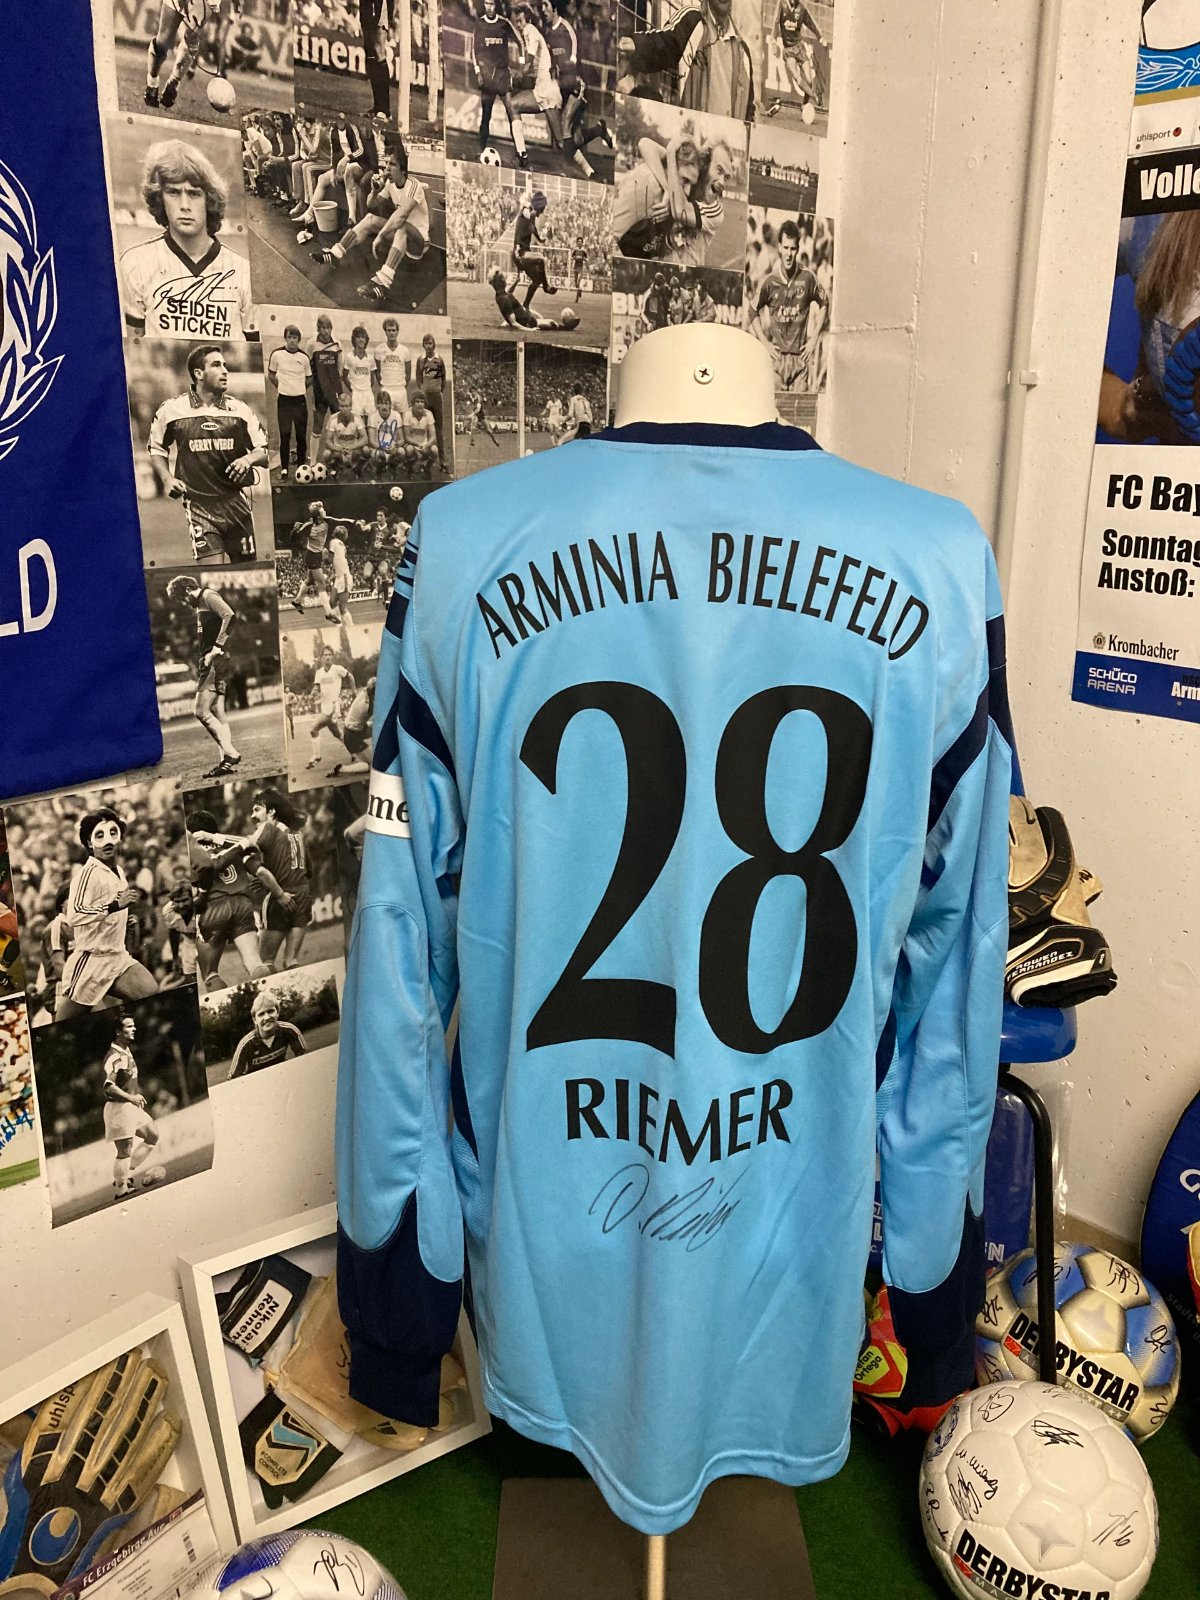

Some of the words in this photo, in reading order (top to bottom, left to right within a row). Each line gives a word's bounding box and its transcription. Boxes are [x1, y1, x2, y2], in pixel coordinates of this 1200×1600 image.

[1136, 130, 1171, 142] uhlsport
[166, 297, 228, 322] SEIDEN
[158, 313, 232, 338] STICKER
[188, 438, 212, 452] GERRY
[213, 438, 235, 451] WEBER
[1106, 474, 1144, 510] FC
[240, 535, 256, 556] 11
[1097, 561, 1196, 598] Anstoß:
[475, 530, 679, 660] ARMINIA
[707, 532, 930, 661] BIELEFELD
[1108, 634, 1180, 661] Krombacher
[1087, 678, 1136, 696] ARENA
[1088, 667, 1138, 684] SCHÜCO
[519, 680, 874, 1060] 28
[1006, 951, 1074, 982] FERNANDEZ
[565, 1077, 794, 1167] RIEMER
[232, 1293, 274, 1340] Rehnen
[241, 1300, 280, 1346] Nikolai
[854, 1355, 883, 1381] Ortega
[856, 1351, 875, 1371] efan
[1009, 1311, 1140, 1412] DEBYSTAR
[48, 1382, 76, 1429] uhlsp
[258, 1458, 280, 1480] CONTROL
[83, 1571, 96, 1588] FC
[96, 1536, 146, 1579] Erzgebirge
